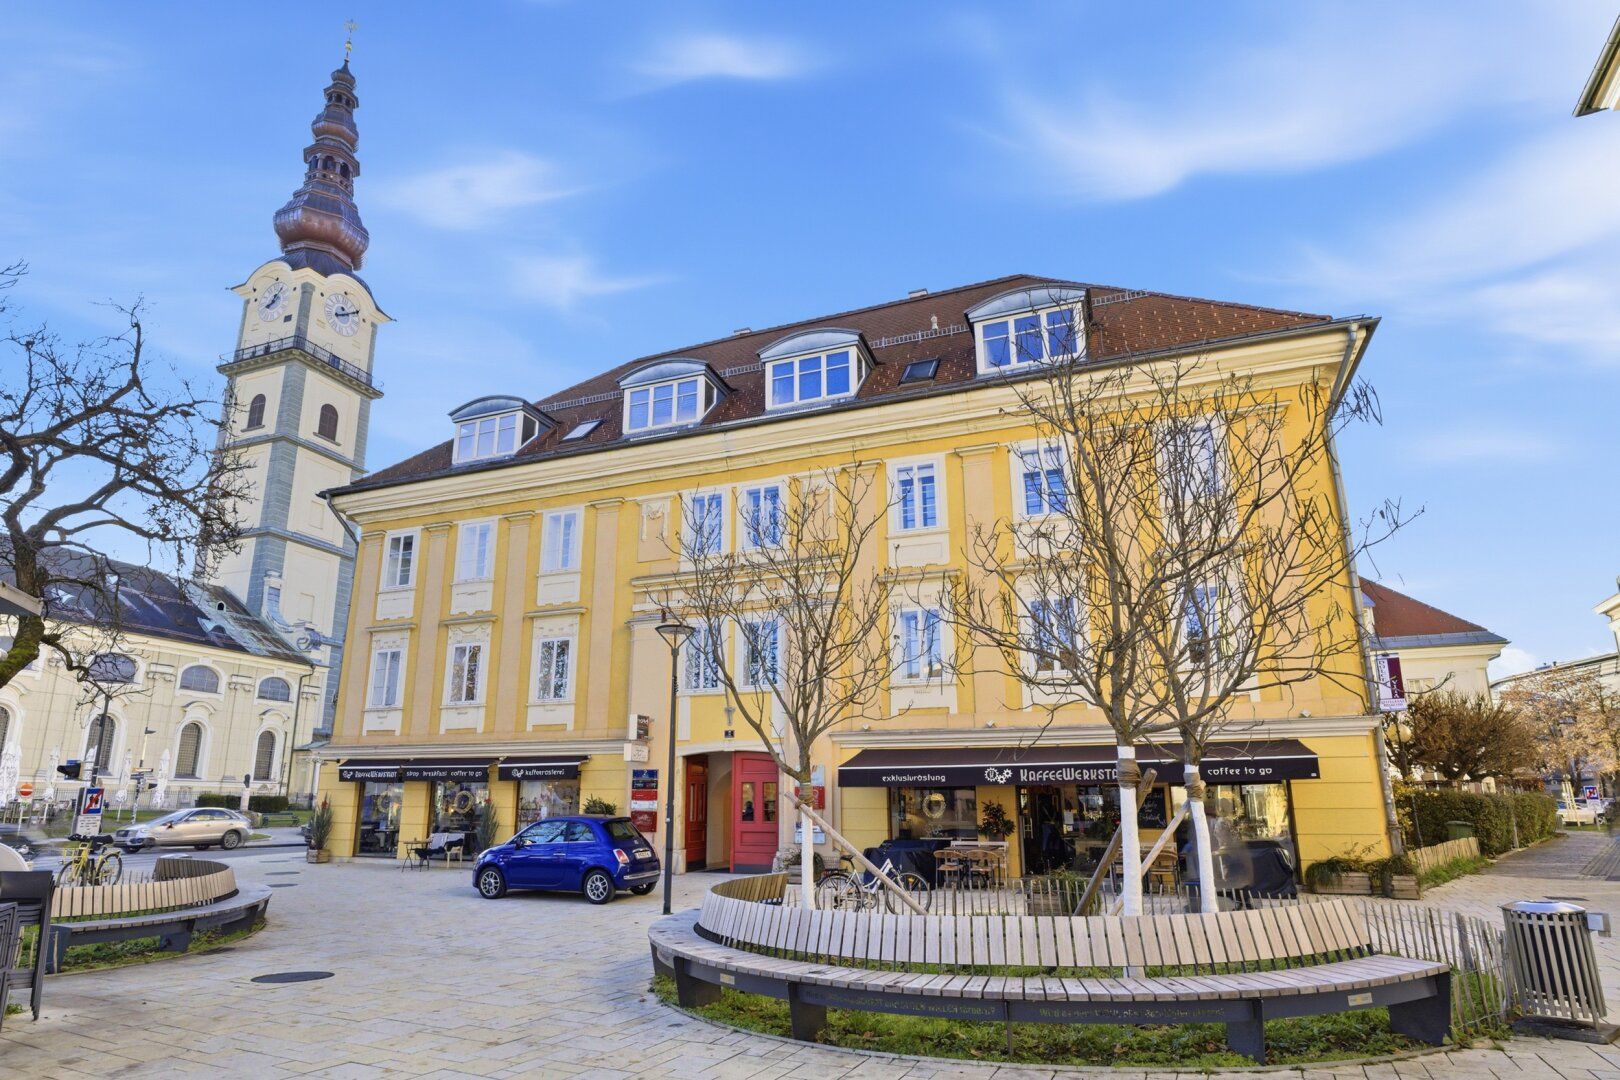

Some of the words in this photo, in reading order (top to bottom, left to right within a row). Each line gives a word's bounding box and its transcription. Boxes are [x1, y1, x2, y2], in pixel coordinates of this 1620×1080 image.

[406, 770, 420, 778] shop
[1020, 767, 1118, 782] KAFFEEWERKSTA
[1207, 767, 1241, 776] coffee
[1244, 766, 1256, 775] to
[1259, 767, 1273, 776] go
